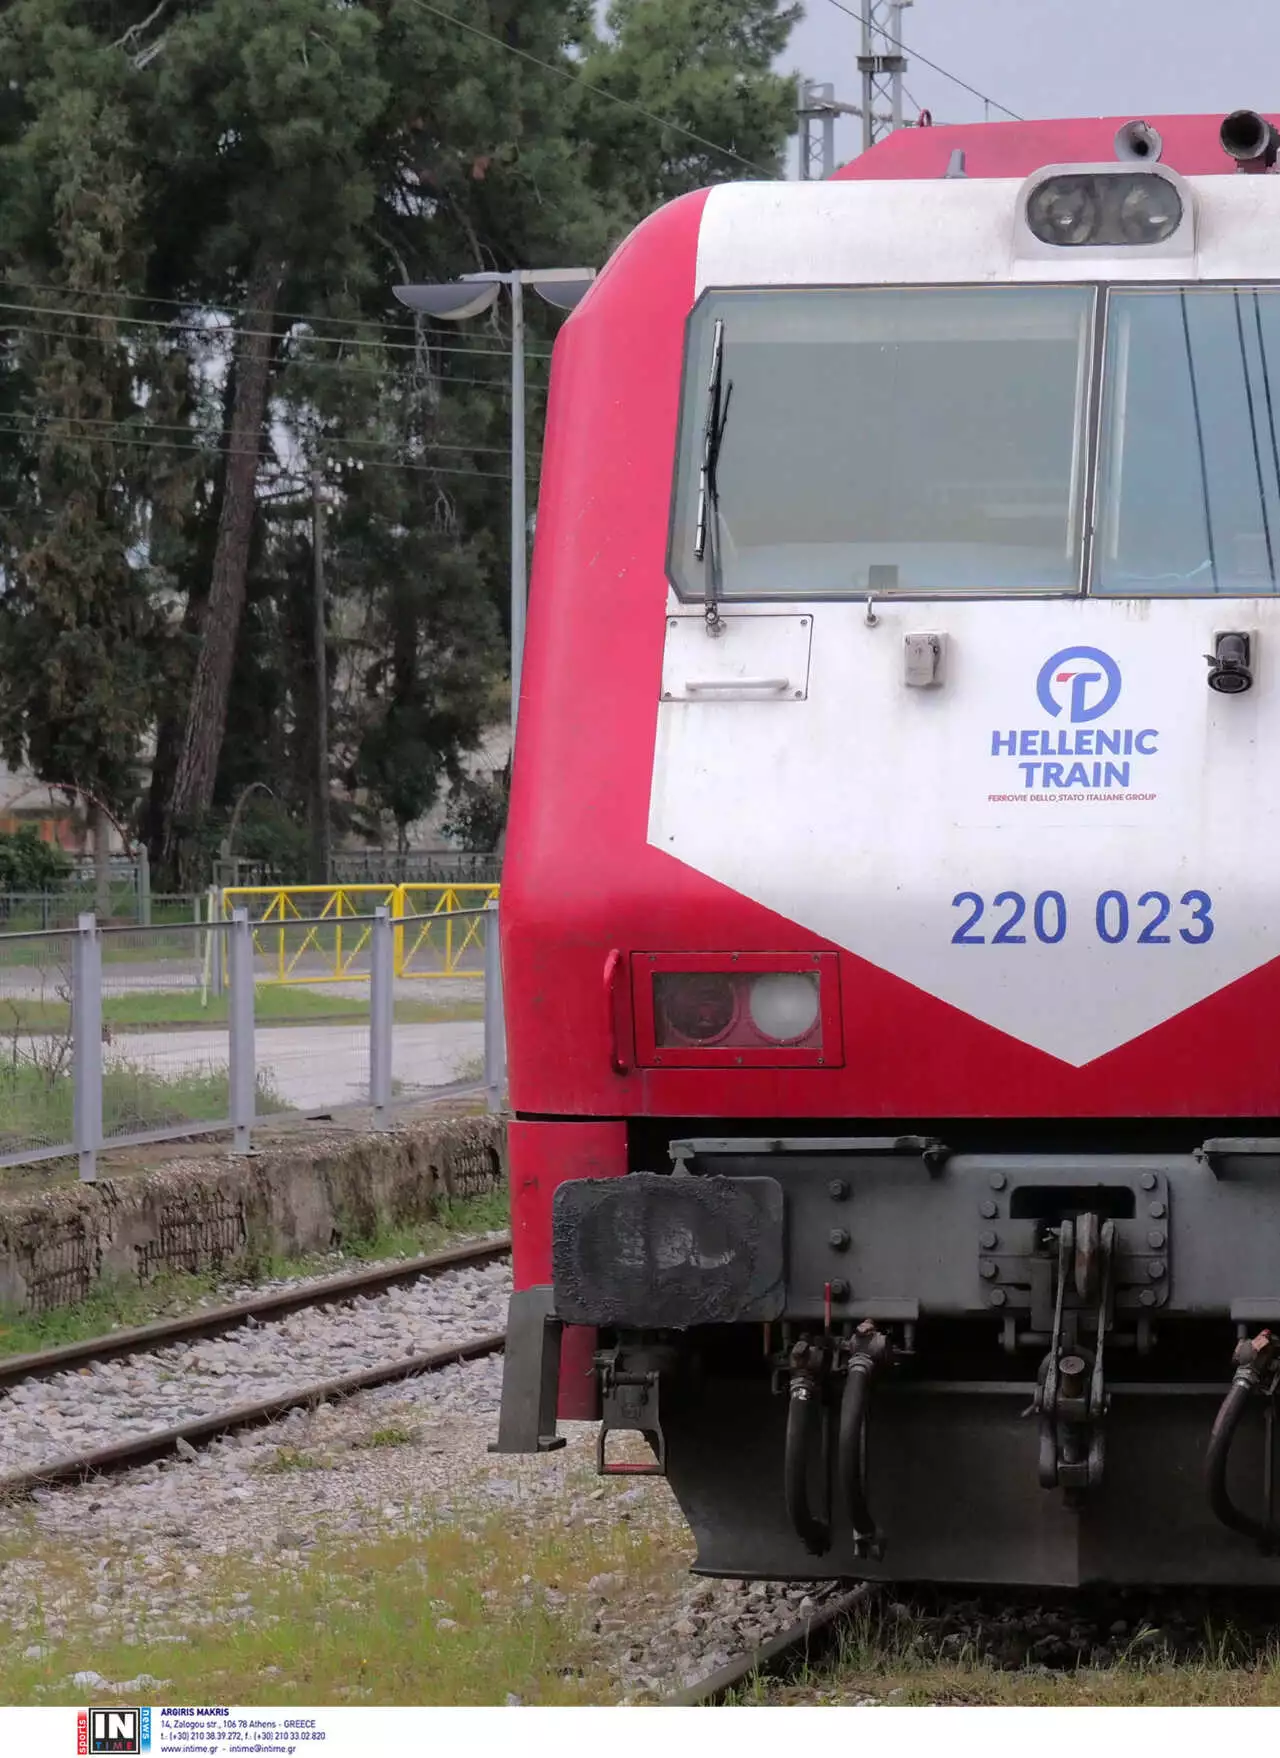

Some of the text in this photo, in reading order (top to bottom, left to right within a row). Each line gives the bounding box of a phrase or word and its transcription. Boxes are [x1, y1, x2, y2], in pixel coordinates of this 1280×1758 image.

[991, 729, 1159, 756] HELLENIC
[1018, 761, 1130, 788] TRAIN
[988, 793, 1157, 802] FERROVIE DELLO STATO ITALIANE GROUP
[951, 889, 1214, 944] 220 023
